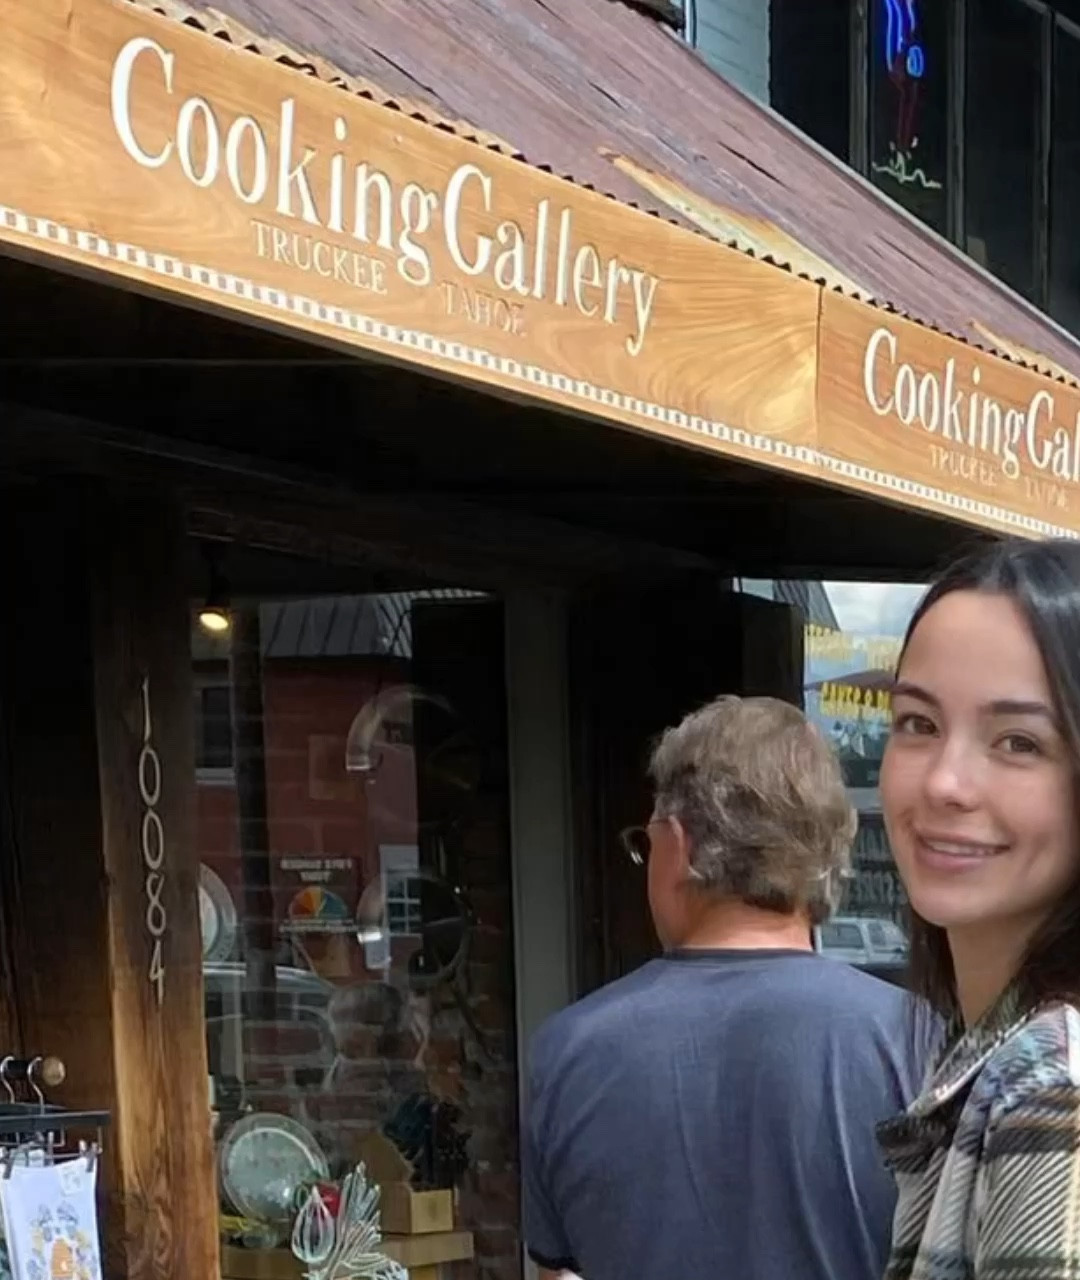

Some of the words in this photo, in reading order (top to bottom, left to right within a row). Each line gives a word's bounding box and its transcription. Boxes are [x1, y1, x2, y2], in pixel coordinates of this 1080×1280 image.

[251, 218, 388, 296] TRUCKEE
[438, 281, 528, 337] TAHOE
[138, 675, 167, 1006] 10084
